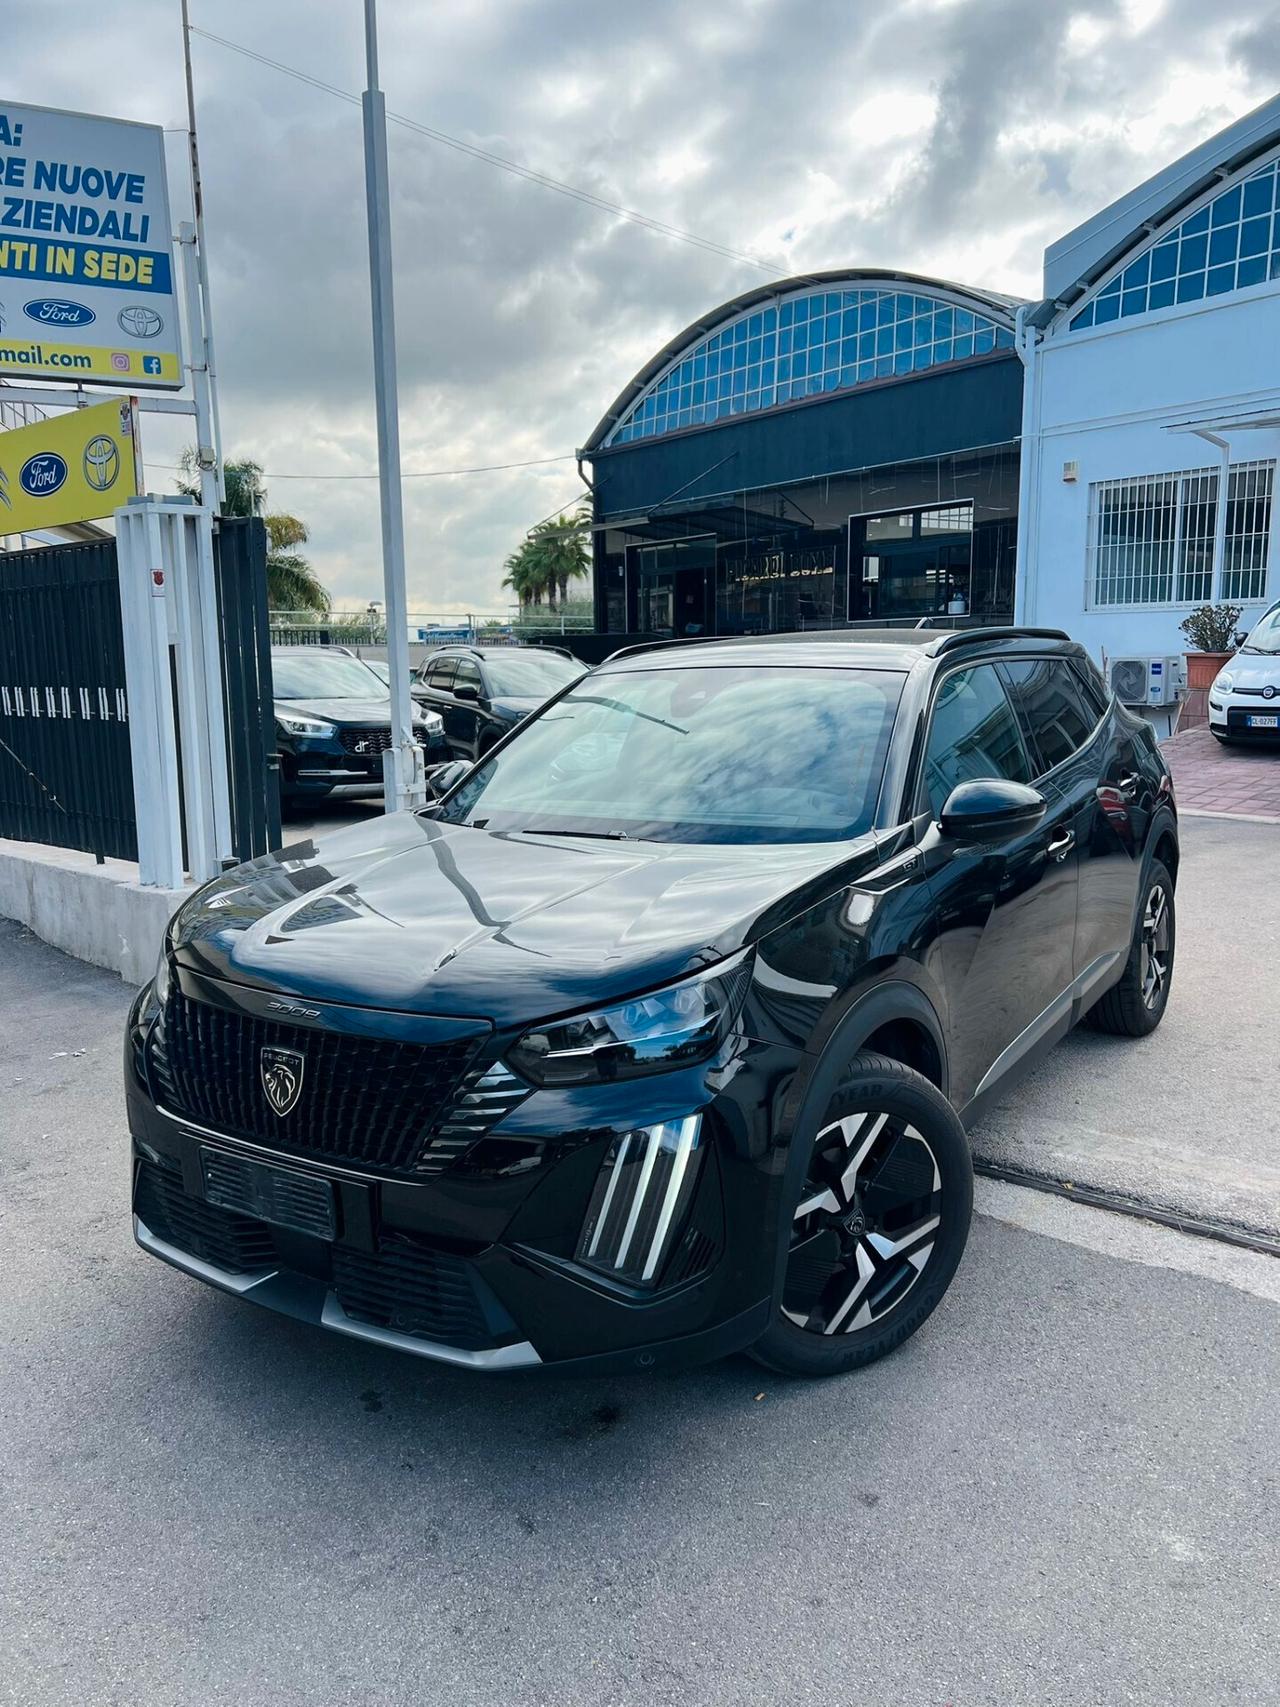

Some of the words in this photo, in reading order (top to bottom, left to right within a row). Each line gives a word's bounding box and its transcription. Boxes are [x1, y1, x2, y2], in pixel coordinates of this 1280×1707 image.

[0, 156, 26, 187] E
[34, 160, 146, 204] NUOVE
[1, 197, 149, 243] ZIENDALI
[46, 245, 75, 276] IN
[83, 249, 154, 285] SEDE
[39, 302, 80, 322] Ford
[0, 345, 92, 368] mail.com
[29, 460, 58, 489] Ford
[266, 1001, 321, 1019] 2008
